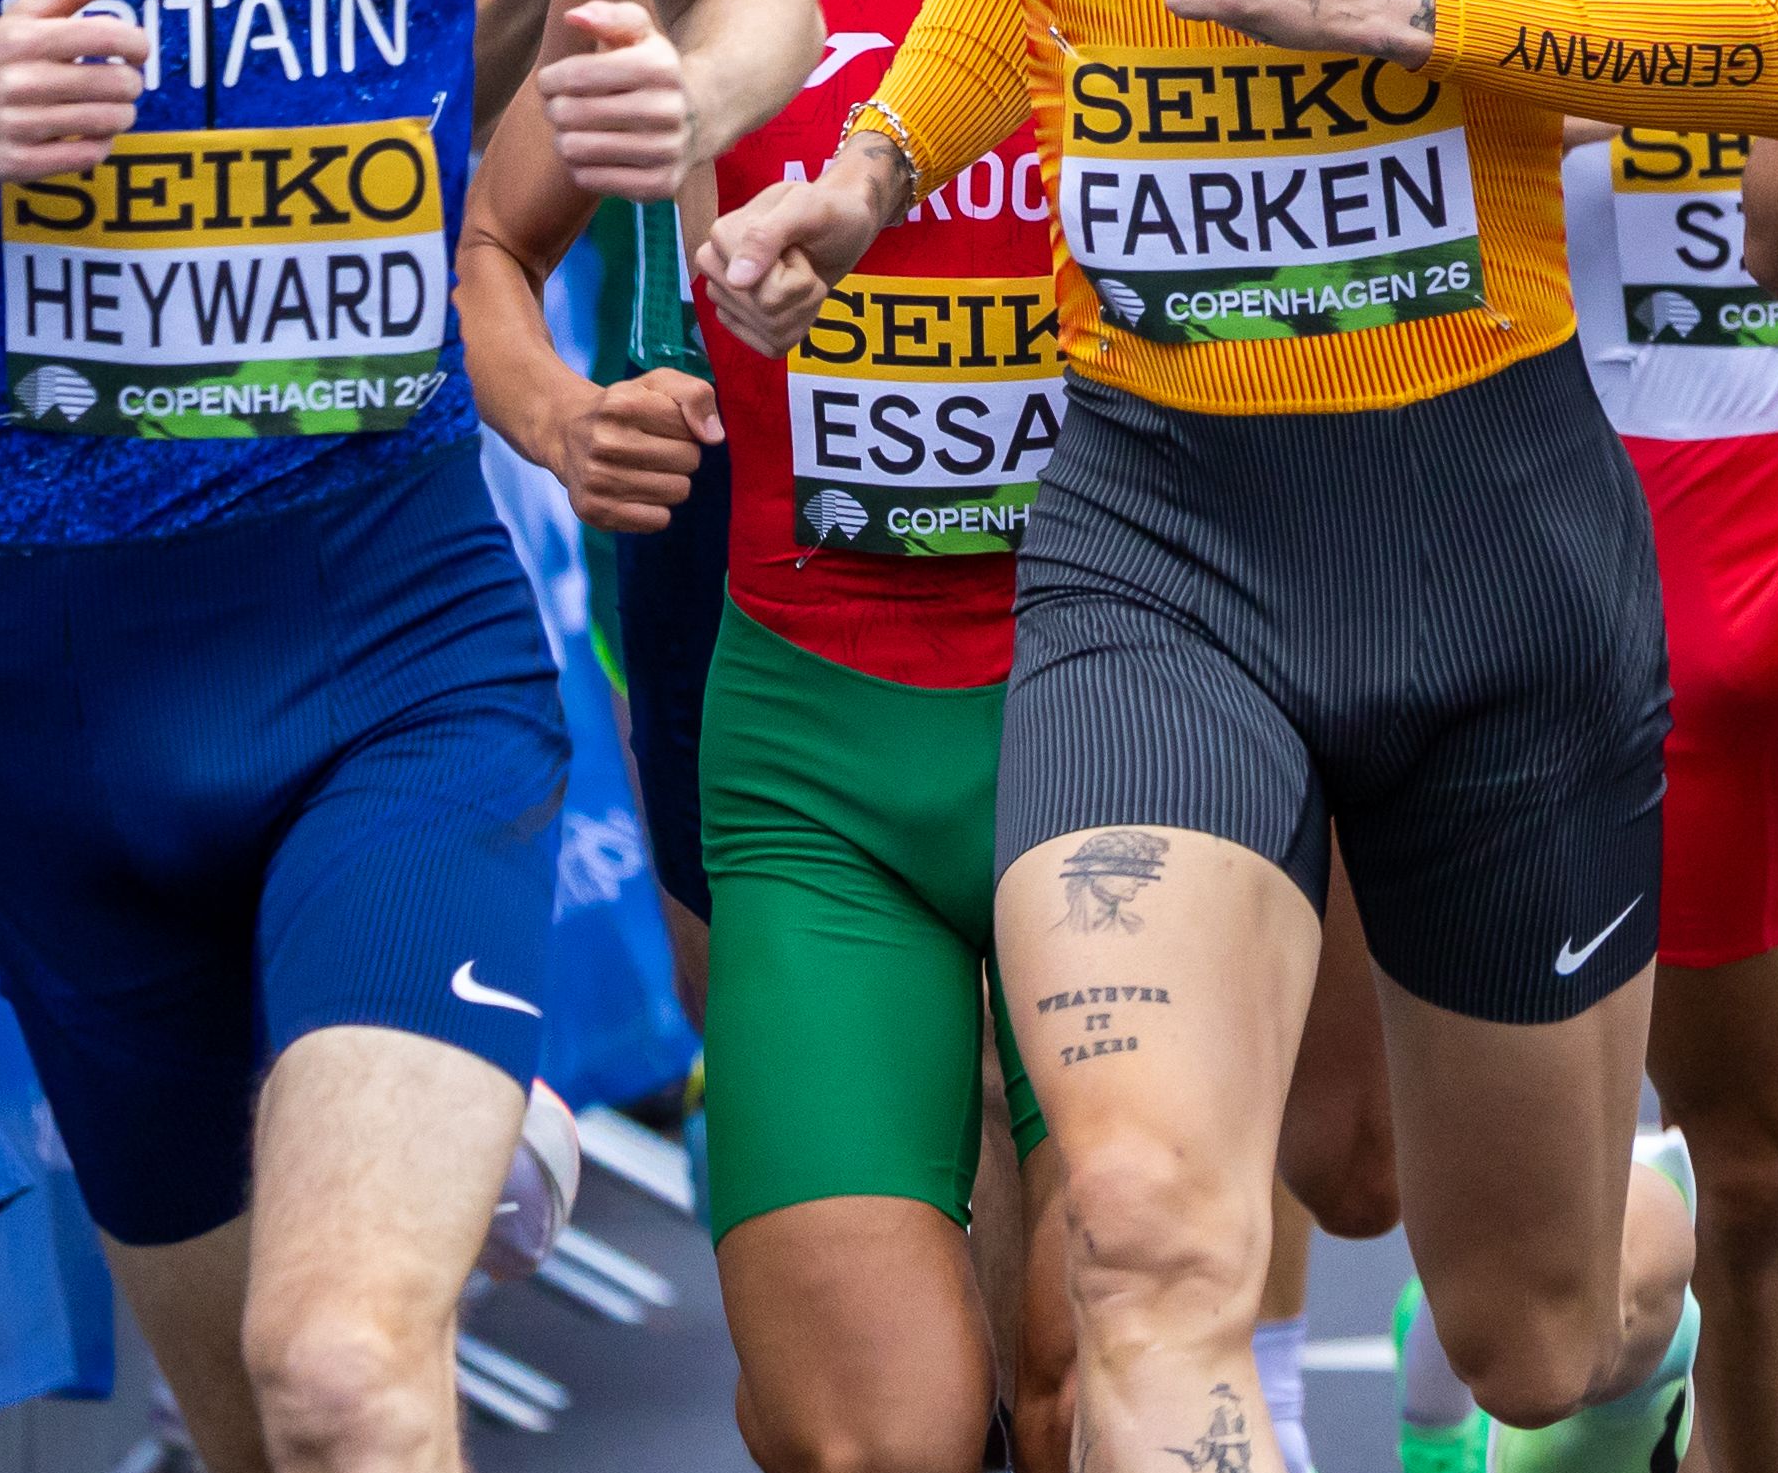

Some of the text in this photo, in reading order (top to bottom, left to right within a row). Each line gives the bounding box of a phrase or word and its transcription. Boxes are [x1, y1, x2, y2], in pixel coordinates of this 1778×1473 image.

[1498, 25, 1764, 88] GERMANY
[1072, 57, 1440, 144] SEIKO
[17, 137, 427, 232] SEIKO
[1079, 145, 1448, 255] FARKEN
[25, 250, 426, 348] HEYWARD
[1165, 261, 1470, 321] COPENHAGEN 26
[118, 378, 385, 417] COPENHAGEN
[1036, 985, 1171, 1014] WHATEVER
[1085, 1013, 1111, 1031] IT
[1060, 1036, 1137, 1066] TAKES
